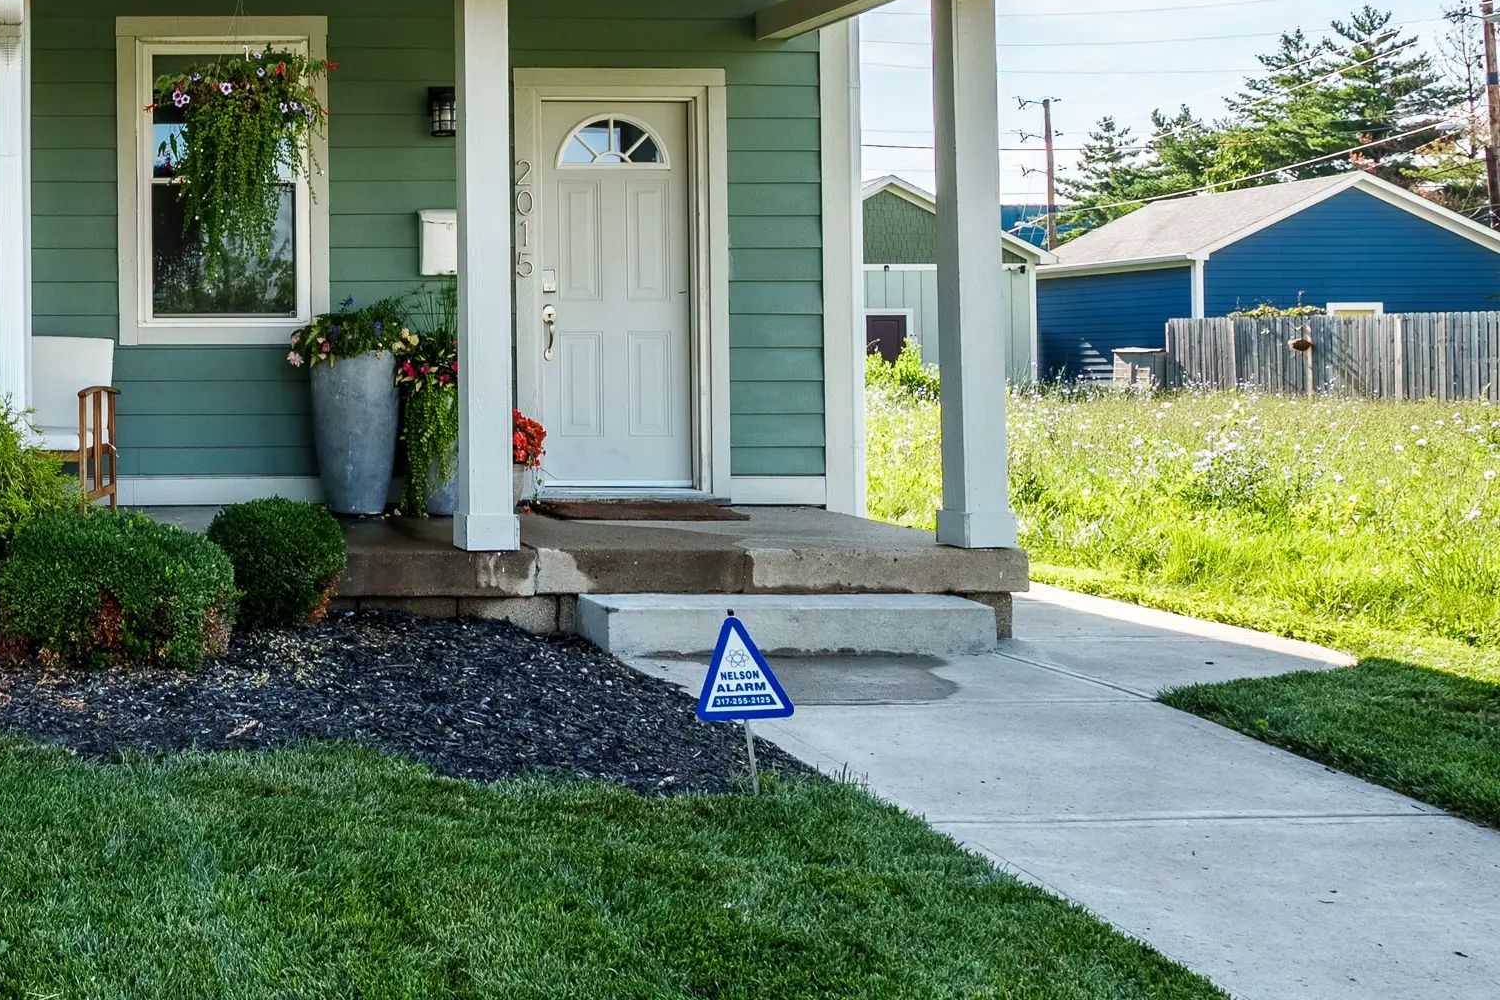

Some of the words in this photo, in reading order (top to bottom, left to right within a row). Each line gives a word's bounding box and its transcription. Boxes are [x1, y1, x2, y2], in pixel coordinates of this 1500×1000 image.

[515, 159, 534, 277] 2015
[720, 670, 760, 681] NELSON
[716, 682, 767, 693] ALARM
